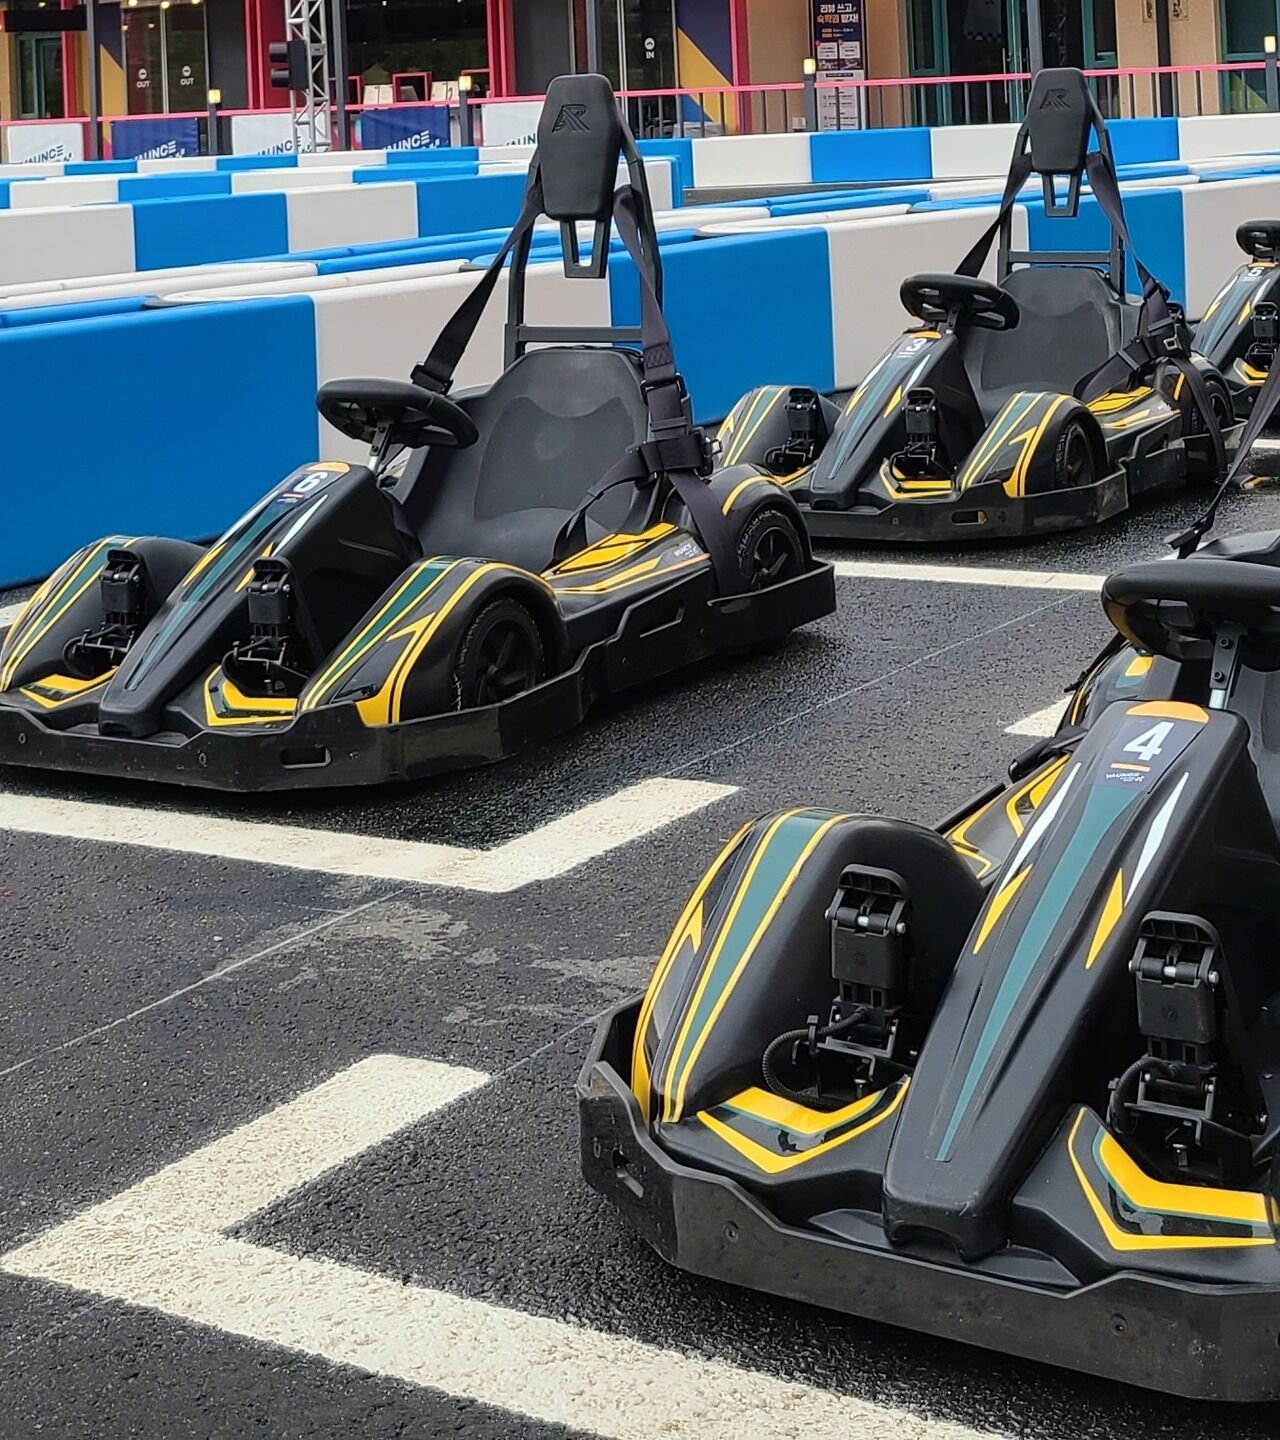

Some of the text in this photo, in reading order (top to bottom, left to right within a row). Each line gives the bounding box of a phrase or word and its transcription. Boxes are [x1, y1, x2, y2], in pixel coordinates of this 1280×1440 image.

[646, 51, 655, 59] IN
[136, 80, 151, 88] OUT
[180, 77, 194, 86] OUT
[21, 145, 63, 164] UNCE
[258, 136, 301, 155] UNCE
[293, 472, 328, 492] 6
[1123, 721, 1175, 761] 4
